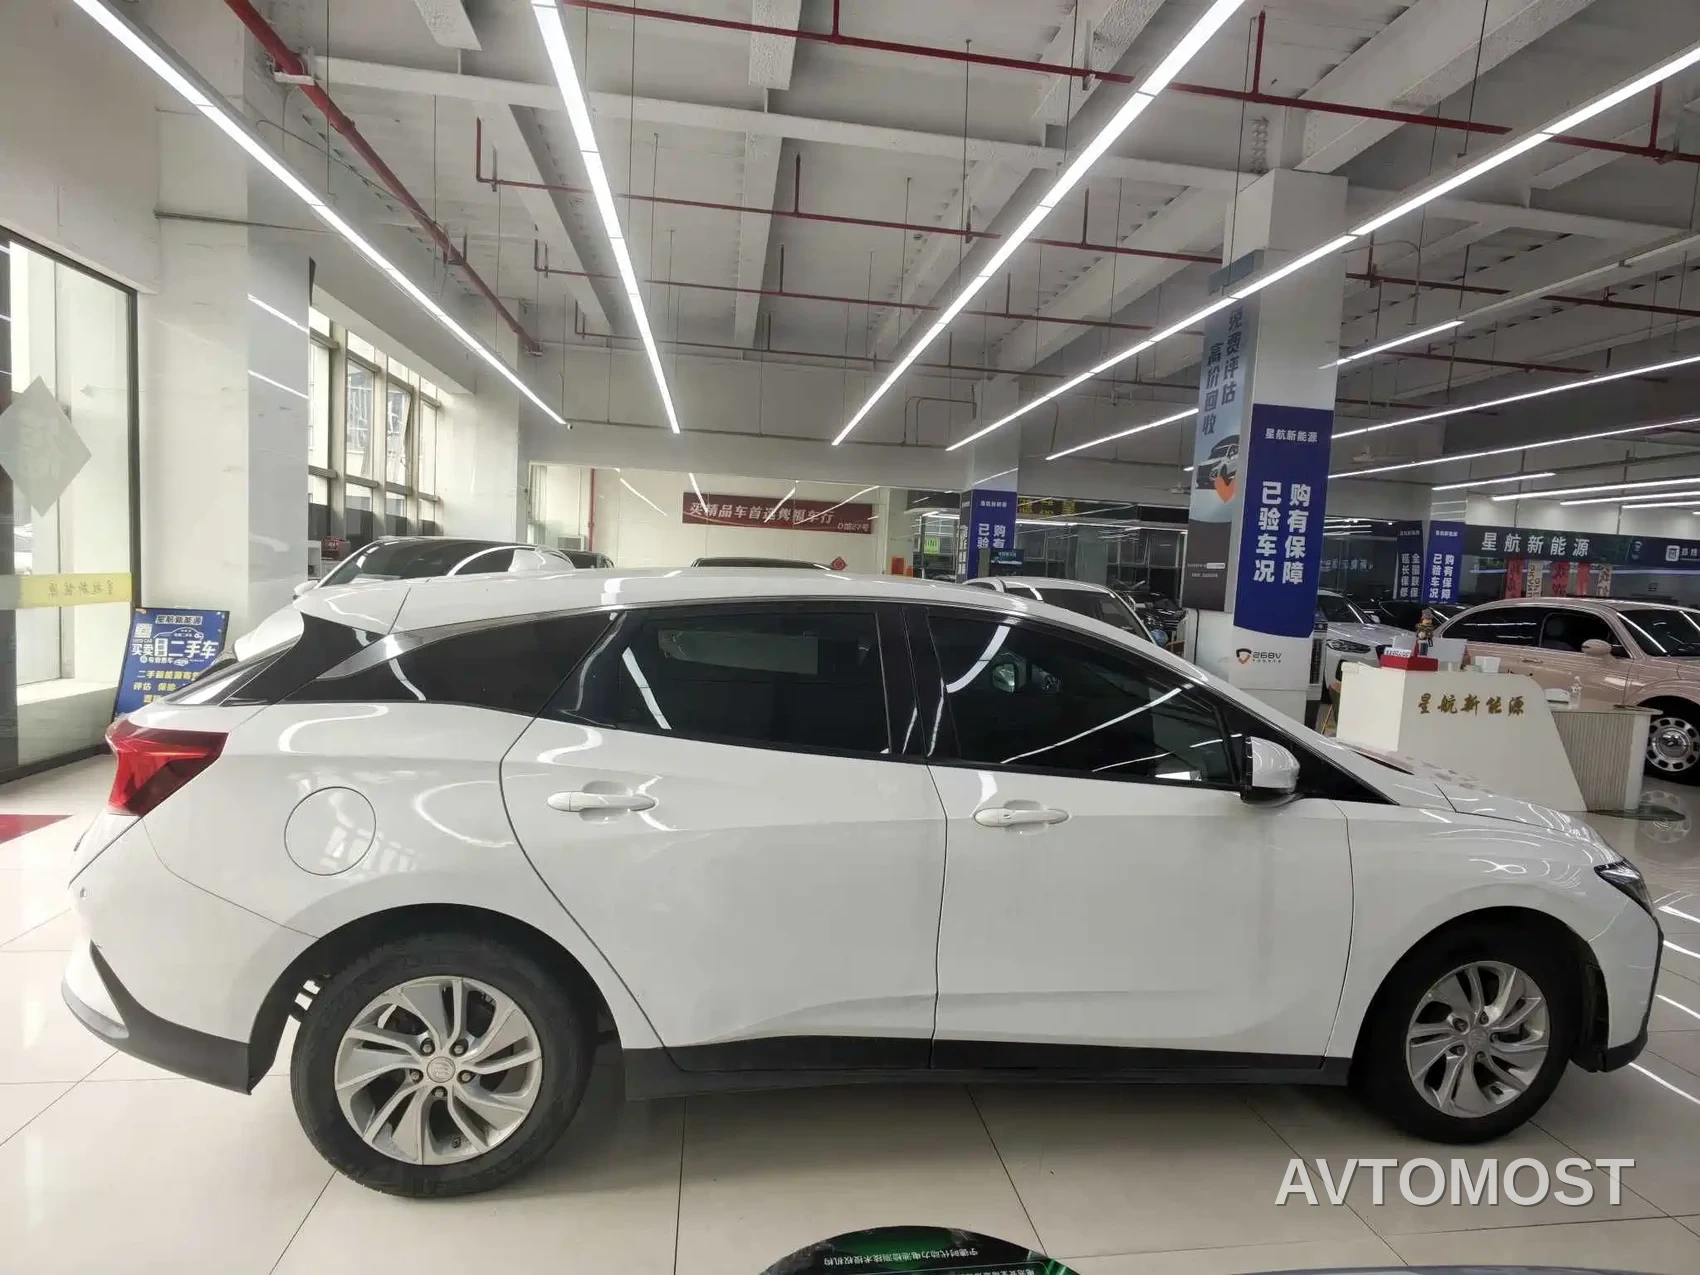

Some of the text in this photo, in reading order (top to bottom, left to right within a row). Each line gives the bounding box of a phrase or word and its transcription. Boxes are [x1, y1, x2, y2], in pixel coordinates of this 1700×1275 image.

[1202, 341, 1224, 436] 高价回收
[1265, 428, 1319, 444] 星航新能源
[1252, 481, 1282, 584] 已验车况
[1282, 482, 1312, 585] 购有保障
[1481, 532, 1591, 557] 星航新能源
[1428, 553, 1443, 599] 已验车况
[1440, 554, 1456, 600] 购有保障
[168, 640, 219, 660] 二手车
[1418, 692, 1526, 717] 星航新能源
